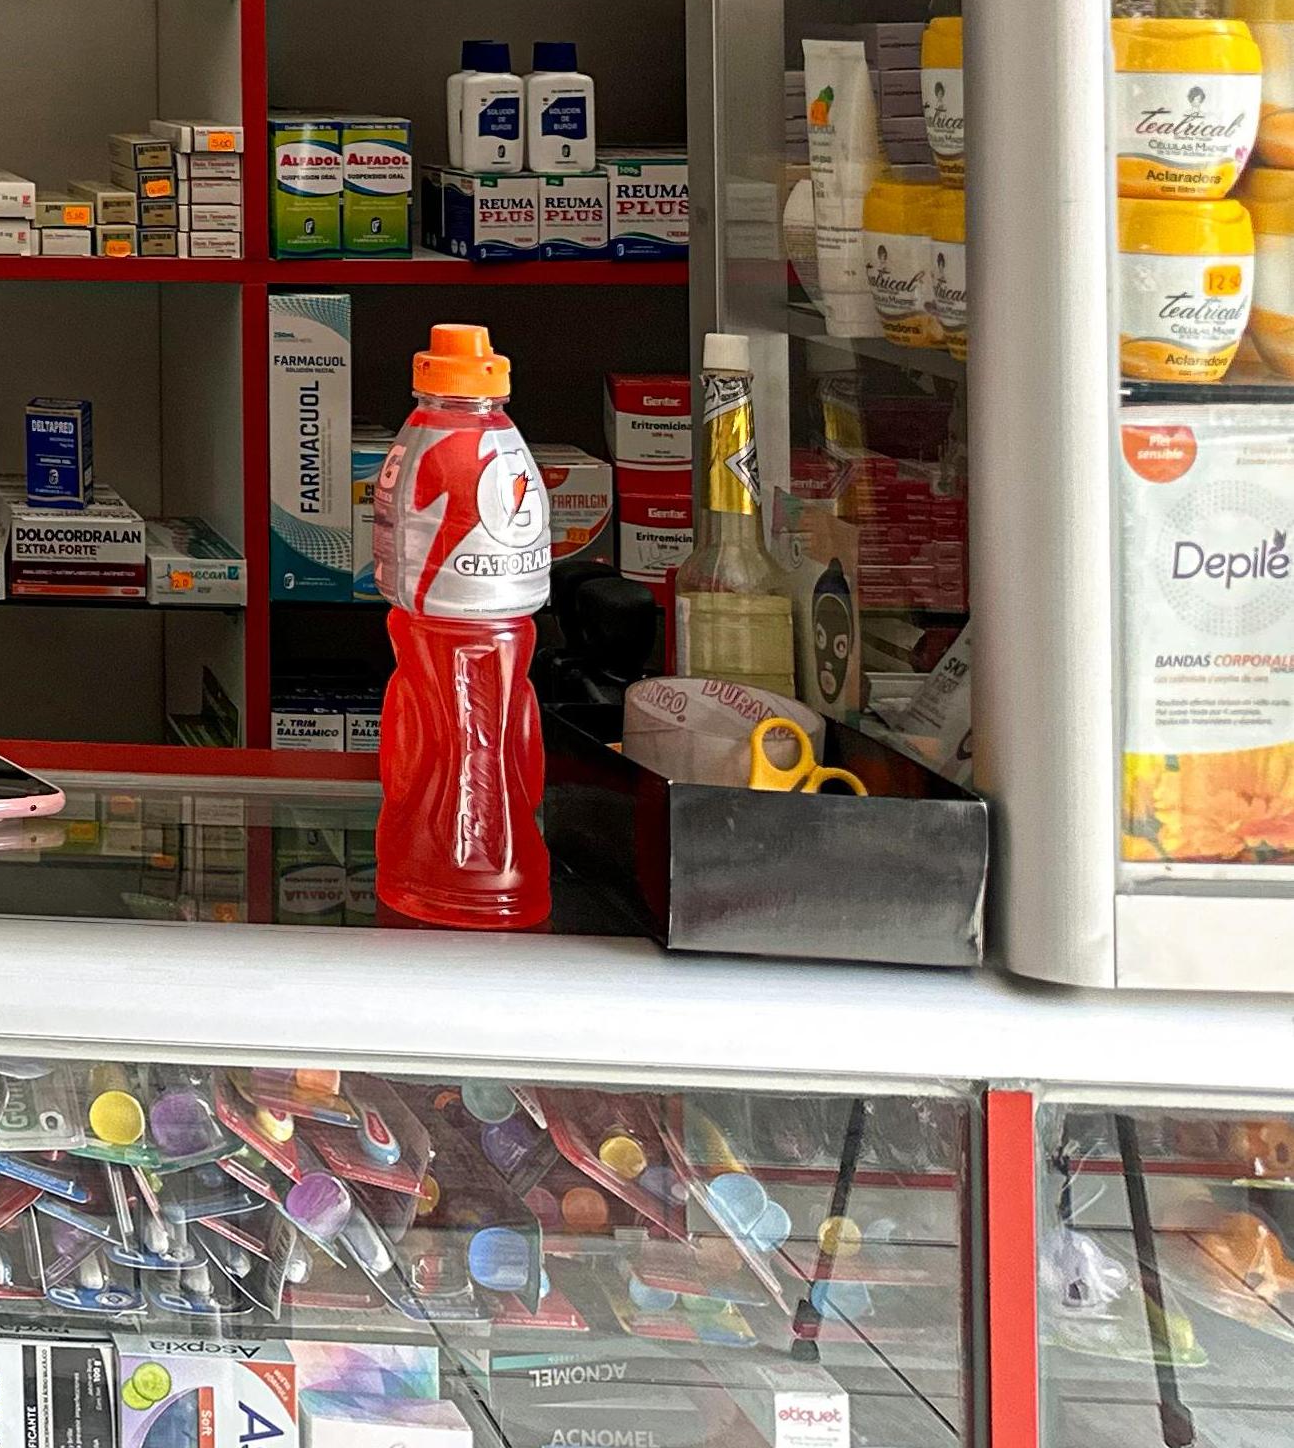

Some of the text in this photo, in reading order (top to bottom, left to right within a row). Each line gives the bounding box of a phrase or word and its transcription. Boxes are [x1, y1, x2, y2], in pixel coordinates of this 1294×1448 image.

[346, 151, 409, 167] ALFADOL
[479, 197, 535, 210] REUMA
[479, 209, 535, 222] PLUS
[273, 354, 347, 368] FARMACUOL
[299, 379, 321, 514] FARMACUOL
[15, 527, 142, 545] DOLOCORDRALAN
[15, 543, 98, 557] EXTRA FORTE
[454, 552, 552, 578] GATORAD
[1154, 653, 1211, 669] BANDAS
[777, 1406, 843, 1427] etiquet
